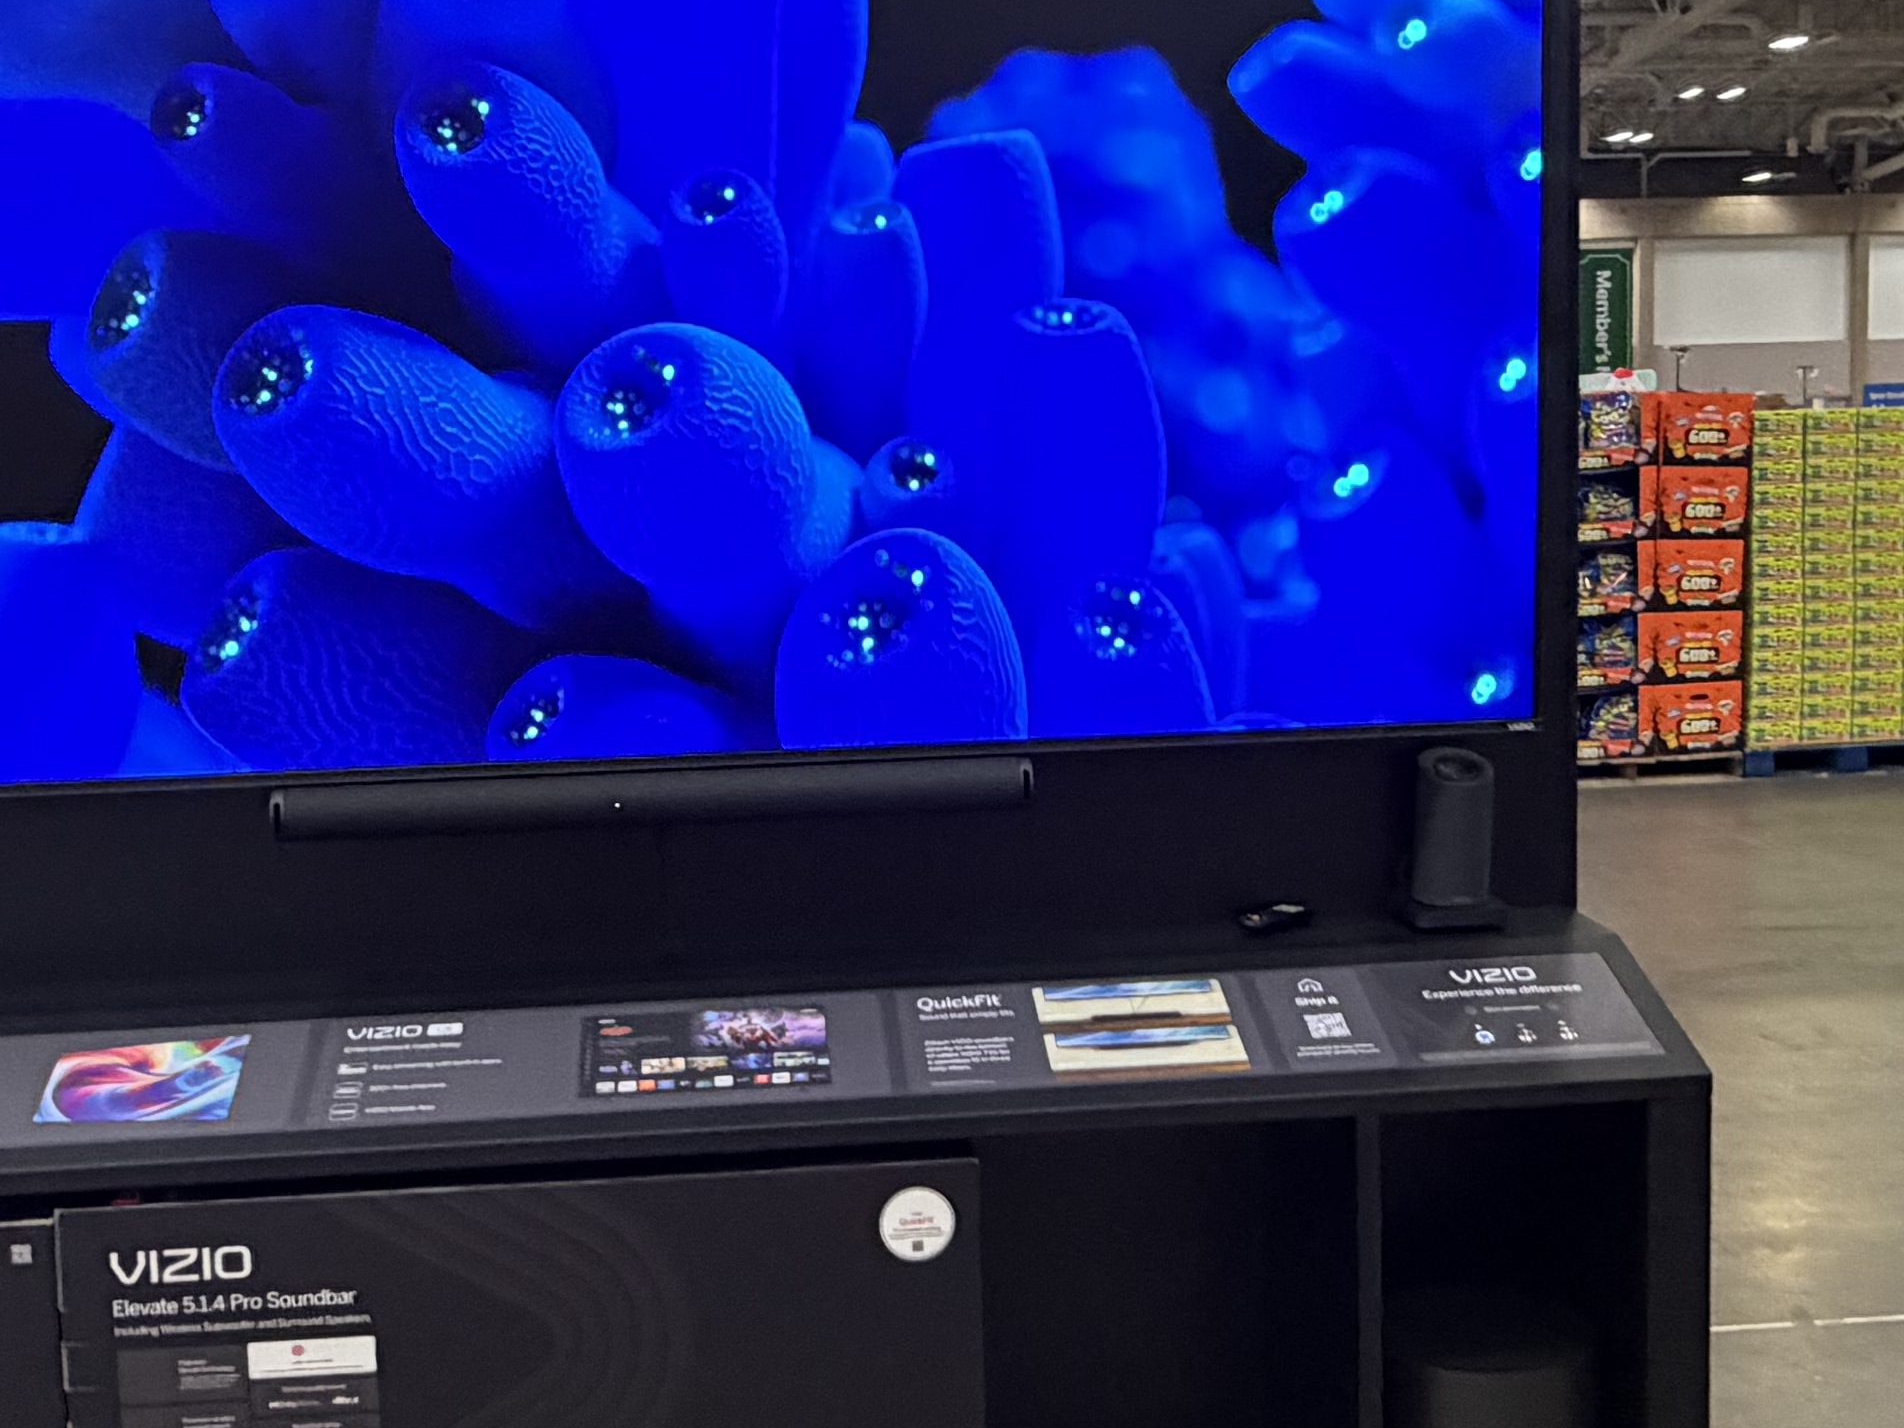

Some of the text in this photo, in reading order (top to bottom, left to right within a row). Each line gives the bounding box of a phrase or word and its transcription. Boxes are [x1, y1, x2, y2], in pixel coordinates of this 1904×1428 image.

[1595, 270, 1612, 365] Member's
[1448, 966, 1537, 984] VIZIO
[347, 1025, 423, 1040] VIZIO
[109, 1245, 252, 1285] VIZIO
[112, 1288, 358, 1318] Elevate 5.1.4 Pro Soundbar
